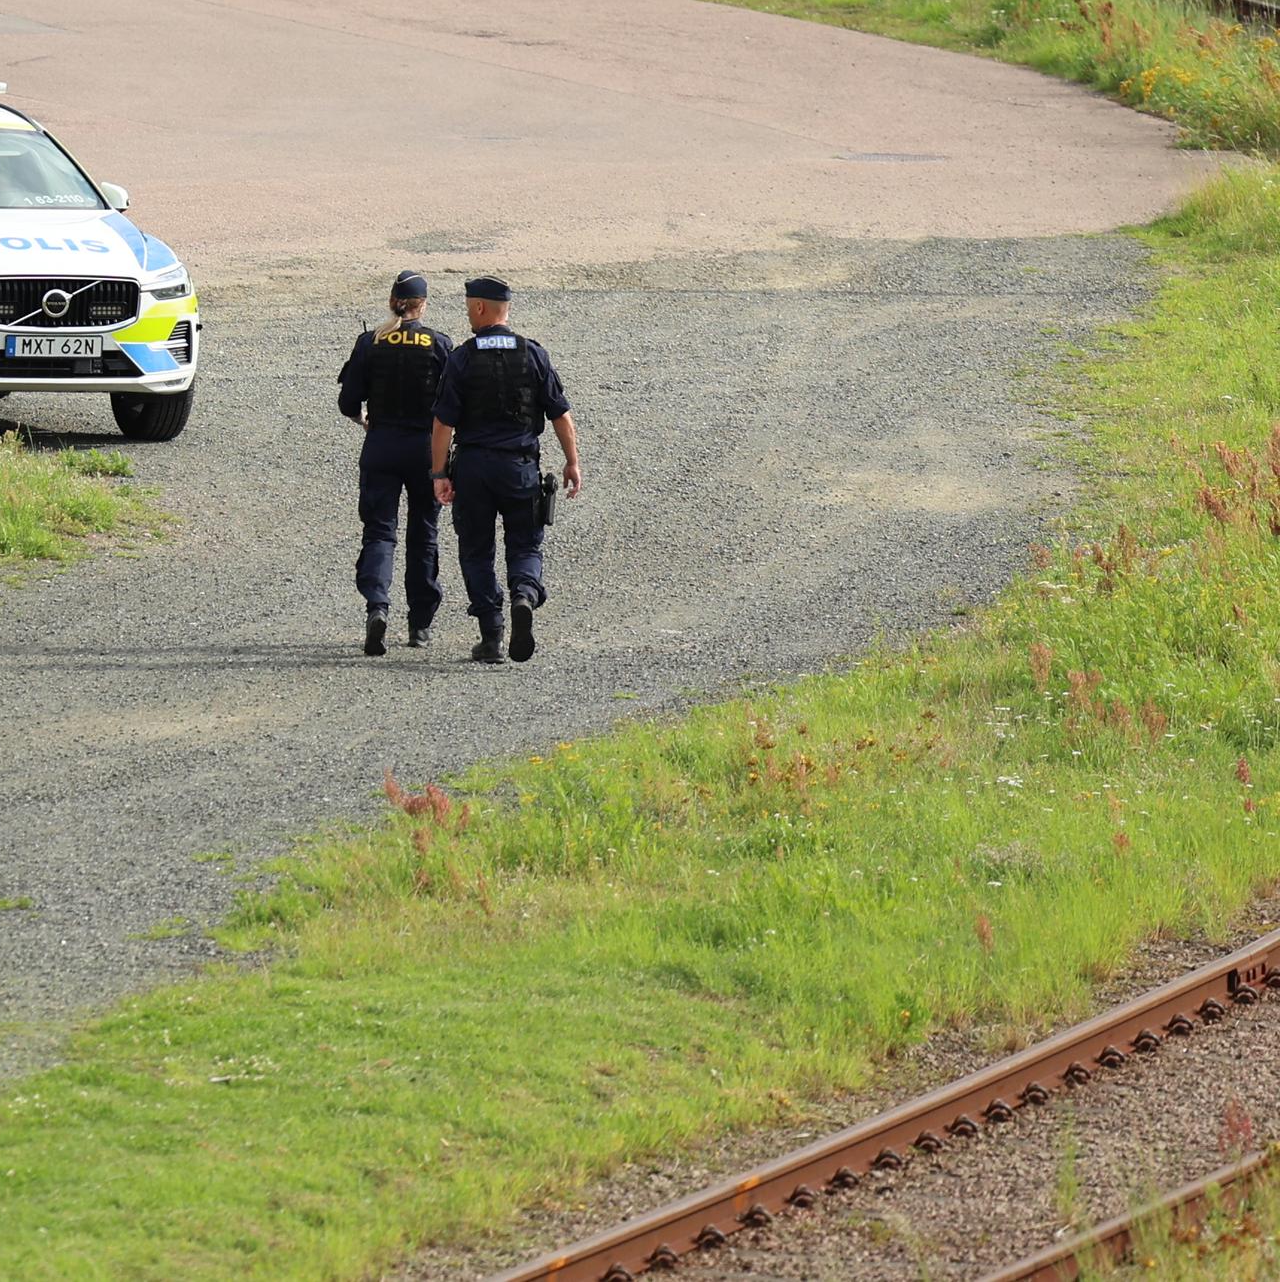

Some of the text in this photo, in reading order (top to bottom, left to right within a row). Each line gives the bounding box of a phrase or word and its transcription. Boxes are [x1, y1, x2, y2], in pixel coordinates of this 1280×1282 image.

[374, 330, 432, 347] POLIS
[479, 337, 516, 349] POLIS
[21, 339, 94, 355] MXT 62N
